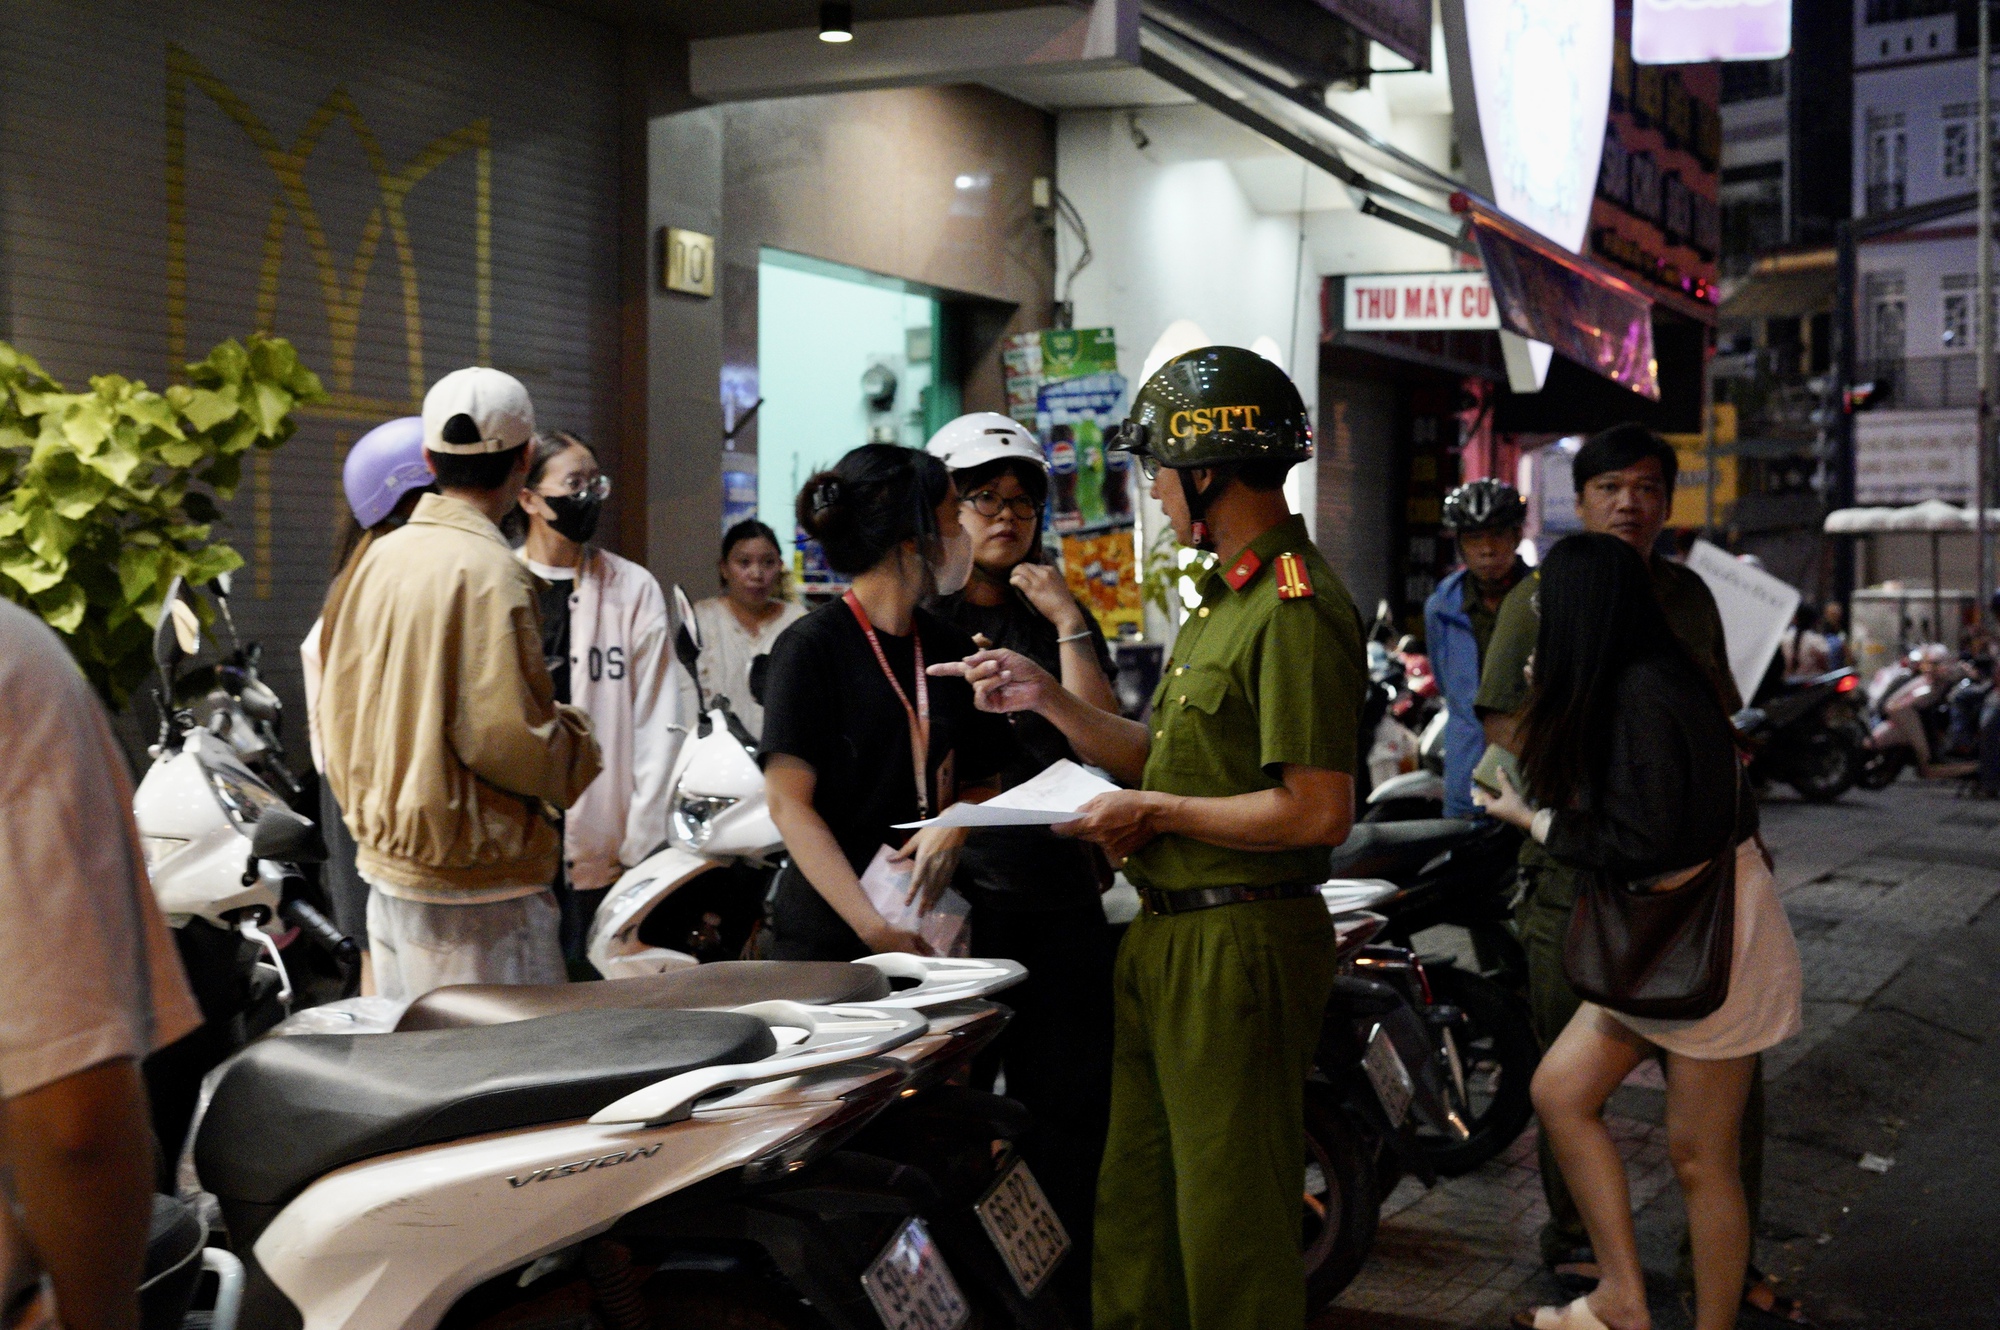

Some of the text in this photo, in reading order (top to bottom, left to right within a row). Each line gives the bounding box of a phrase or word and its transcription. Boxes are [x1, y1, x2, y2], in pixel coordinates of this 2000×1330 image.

[674, 241, 705, 283] 10
[1355, 288, 1397, 319] THU
[1404, 279, 1453, 318] MÁY
[1169, 405, 1260, 438] CSTT
[506, 1142, 663, 1188] VISION
